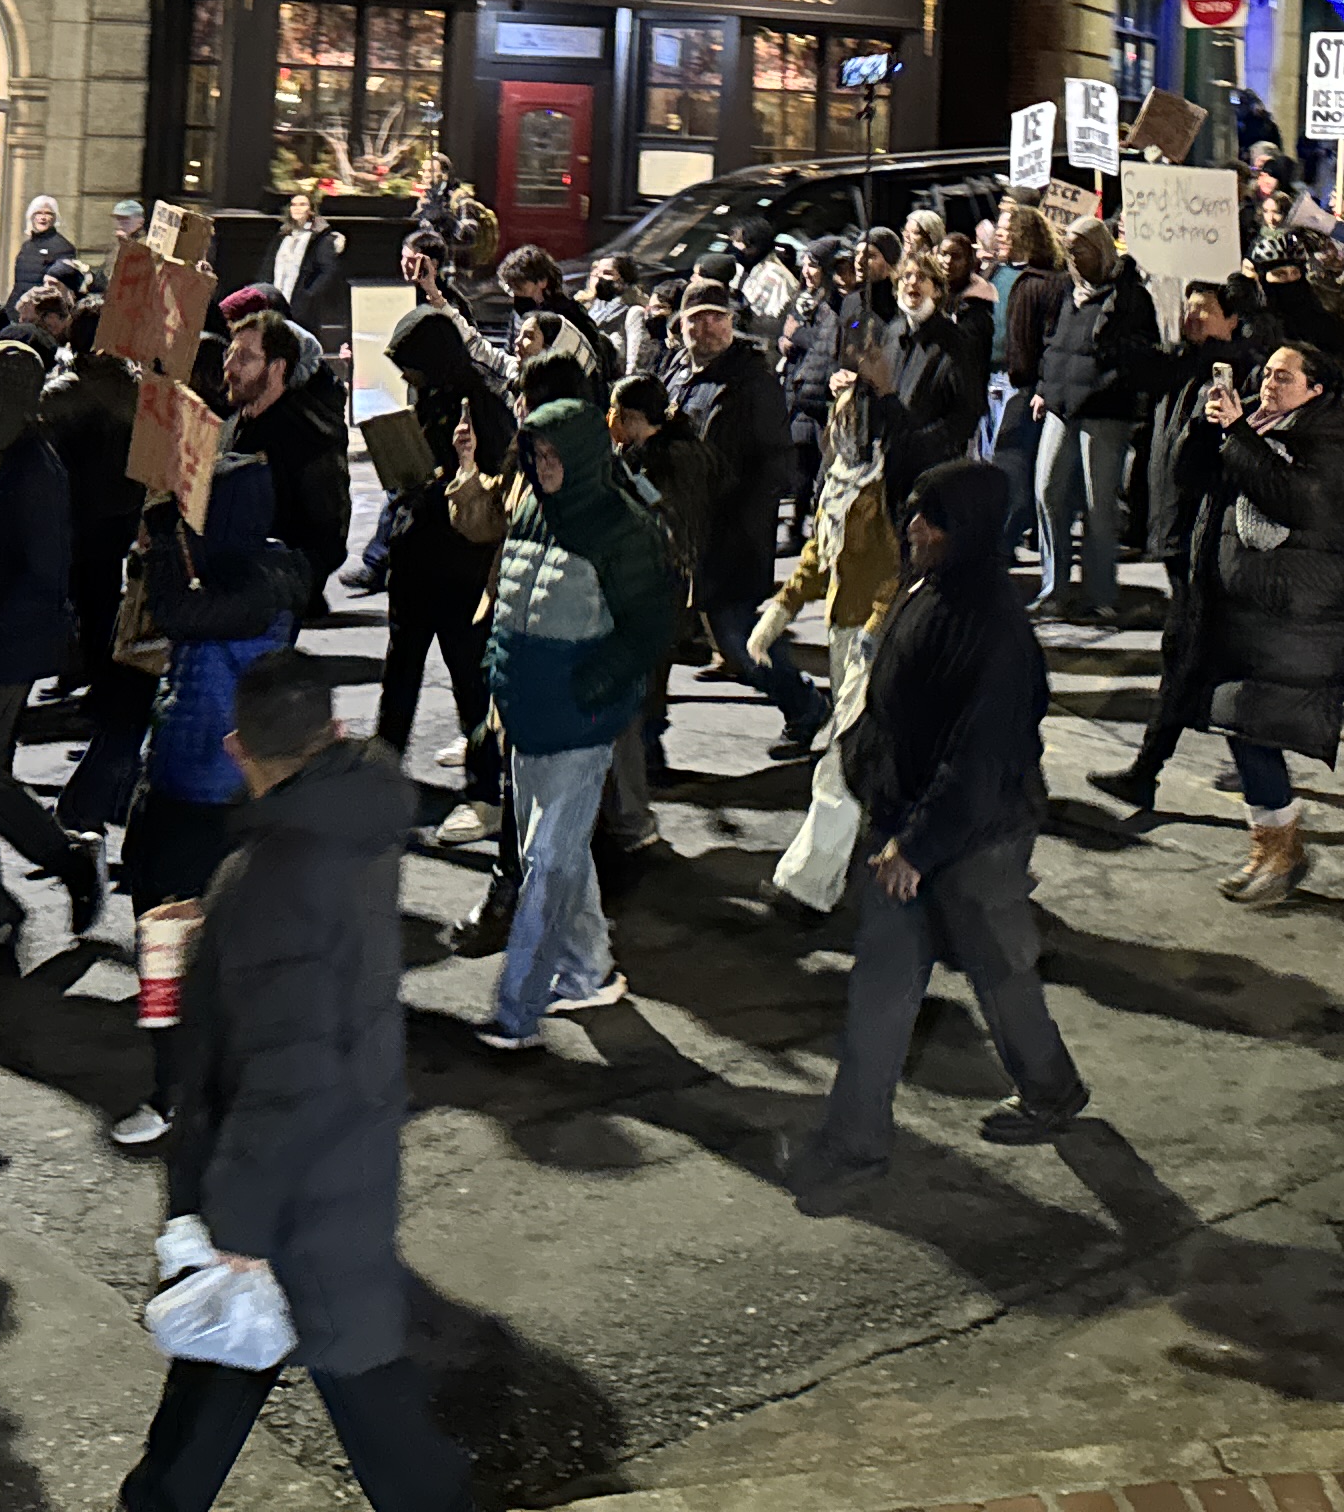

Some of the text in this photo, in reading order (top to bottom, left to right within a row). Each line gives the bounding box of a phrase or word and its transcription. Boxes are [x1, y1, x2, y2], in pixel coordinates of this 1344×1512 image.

[1194, 1, 1234, 14] ENTER
[1312, 90, 1332, 108] ICE
[1123, 170, 1168, 212] Send
[1126, 210, 1153, 240] To
